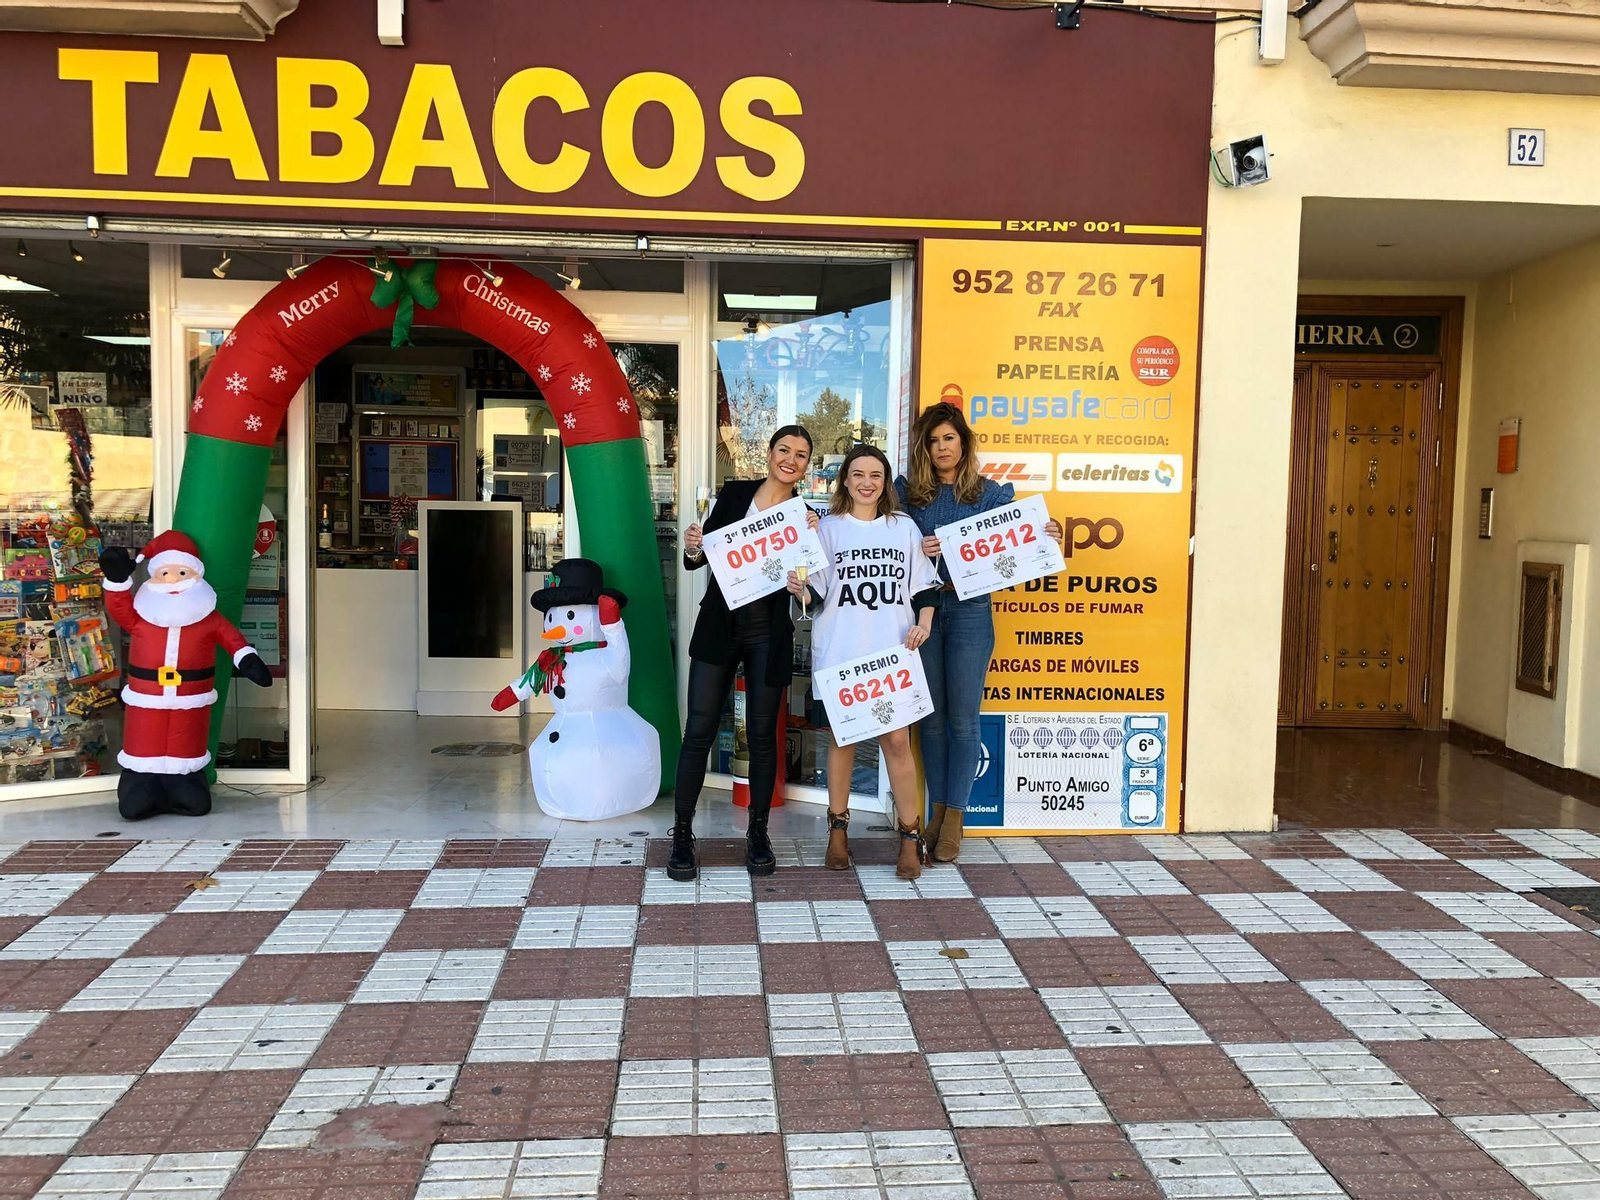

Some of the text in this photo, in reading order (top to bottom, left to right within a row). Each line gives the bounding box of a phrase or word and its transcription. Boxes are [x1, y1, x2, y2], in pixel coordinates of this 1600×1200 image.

[58, 48, 806, 202] TABACOS
[1517, 135, 1538, 161] 52
[1083, 221, 1120, 232] 001
[952, 269, 1164, 297] 952 87 26 71
[277, 280, 340, 328] Merry
[463, 274, 551, 336] Christmas
[1038, 301, 1082, 317] FAX
[1014, 335, 1104, 352] PRENSA
[1297, 324, 1384, 346] IERRA
[1137, 347, 1160, 355] COMPRA
[1145, 356, 1174, 365] PERIÓDICO
[996, 361, 1120, 380] PAPELERÍA
[1139, 368, 1170, 376] SUR
[970, 390, 1172, 425] paysafecard
[993, 434, 1010, 444] DE
[1015, 434, 1079, 445] ENTREGA
[1084, 435, 1093, 445] Y
[1096, 435, 1169, 446] RECOGIDA:
[1062, 464, 1150, 481] celeritas
[724, 511, 785, 544] 3er PREMIO
[960, 508, 1021, 537] 5º PREMIO
[727, 526, 798, 569] 00750
[960, 524, 1036, 562] 66212
[835, 550, 849, 564] 3er
[852, 548, 905, 563] PREMIO
[1024, 576, 1058, 593] DE
[1068, 576, 1158, 594] PUROS
[993, 600, 1144, 614] TÍCULOS DE FUMAR
[1015, 631, 1084, 645] TIMBRES
[839, 654, 899, 681] 5º PREMIO
[1046, 659, 1066, 673] DE
[1071, 656, 1140, 673] MÓVILES
[838, 669, 913, 707] 66212
[983, 687, 1165, 701] TAS INTERNACIONALES
[1139, 738, 1154, 752] 6ª
[1018, 751, 1058, 759] LOTERÍA
[1140, 769, 1150, 778] 5ª
[1017, 776, 1110, 793] PUNTO AMIGO
[965, 804, 998, 813] Nacional
[1041, 795, 1085, 811] 50245
